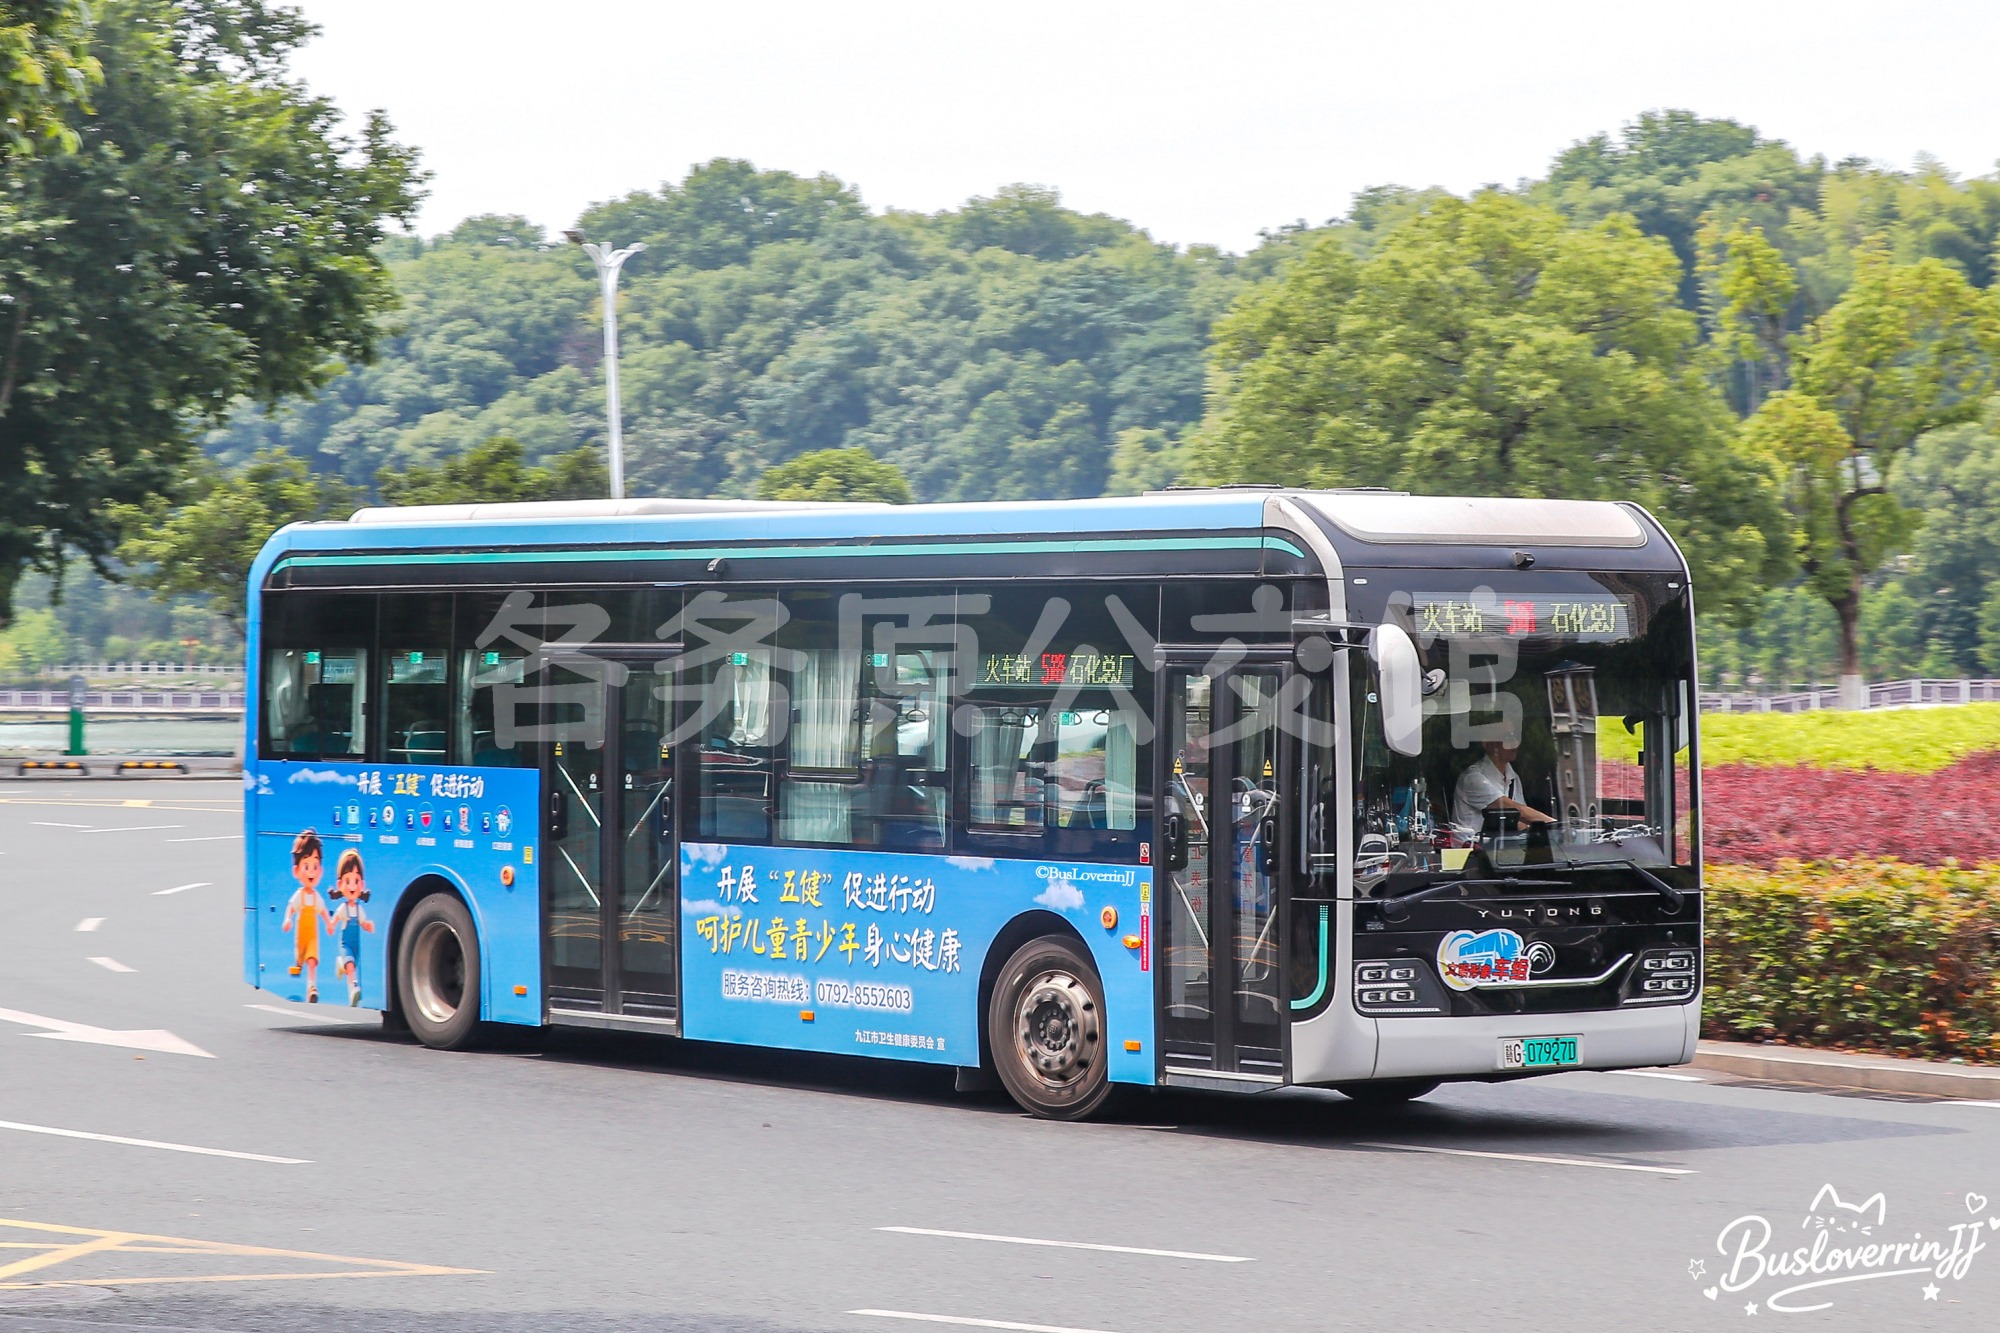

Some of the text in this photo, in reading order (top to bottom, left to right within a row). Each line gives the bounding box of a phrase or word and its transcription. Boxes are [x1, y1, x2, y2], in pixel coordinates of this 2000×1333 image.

[1422, 600, 1483, 633] 火车站
[1550, 603, 1628, 633] 石化总厂
[984, 653, 1032, 684] 火车站
[1069, 655, 1134, 684] 石化总厂
[1478, 907, 1602, 918] YUTONG
[696, 914, 963, 973] 呵护儿童青少年身心健康
[855, 1029, 935, 1050] 九江市卫生健康委员会
